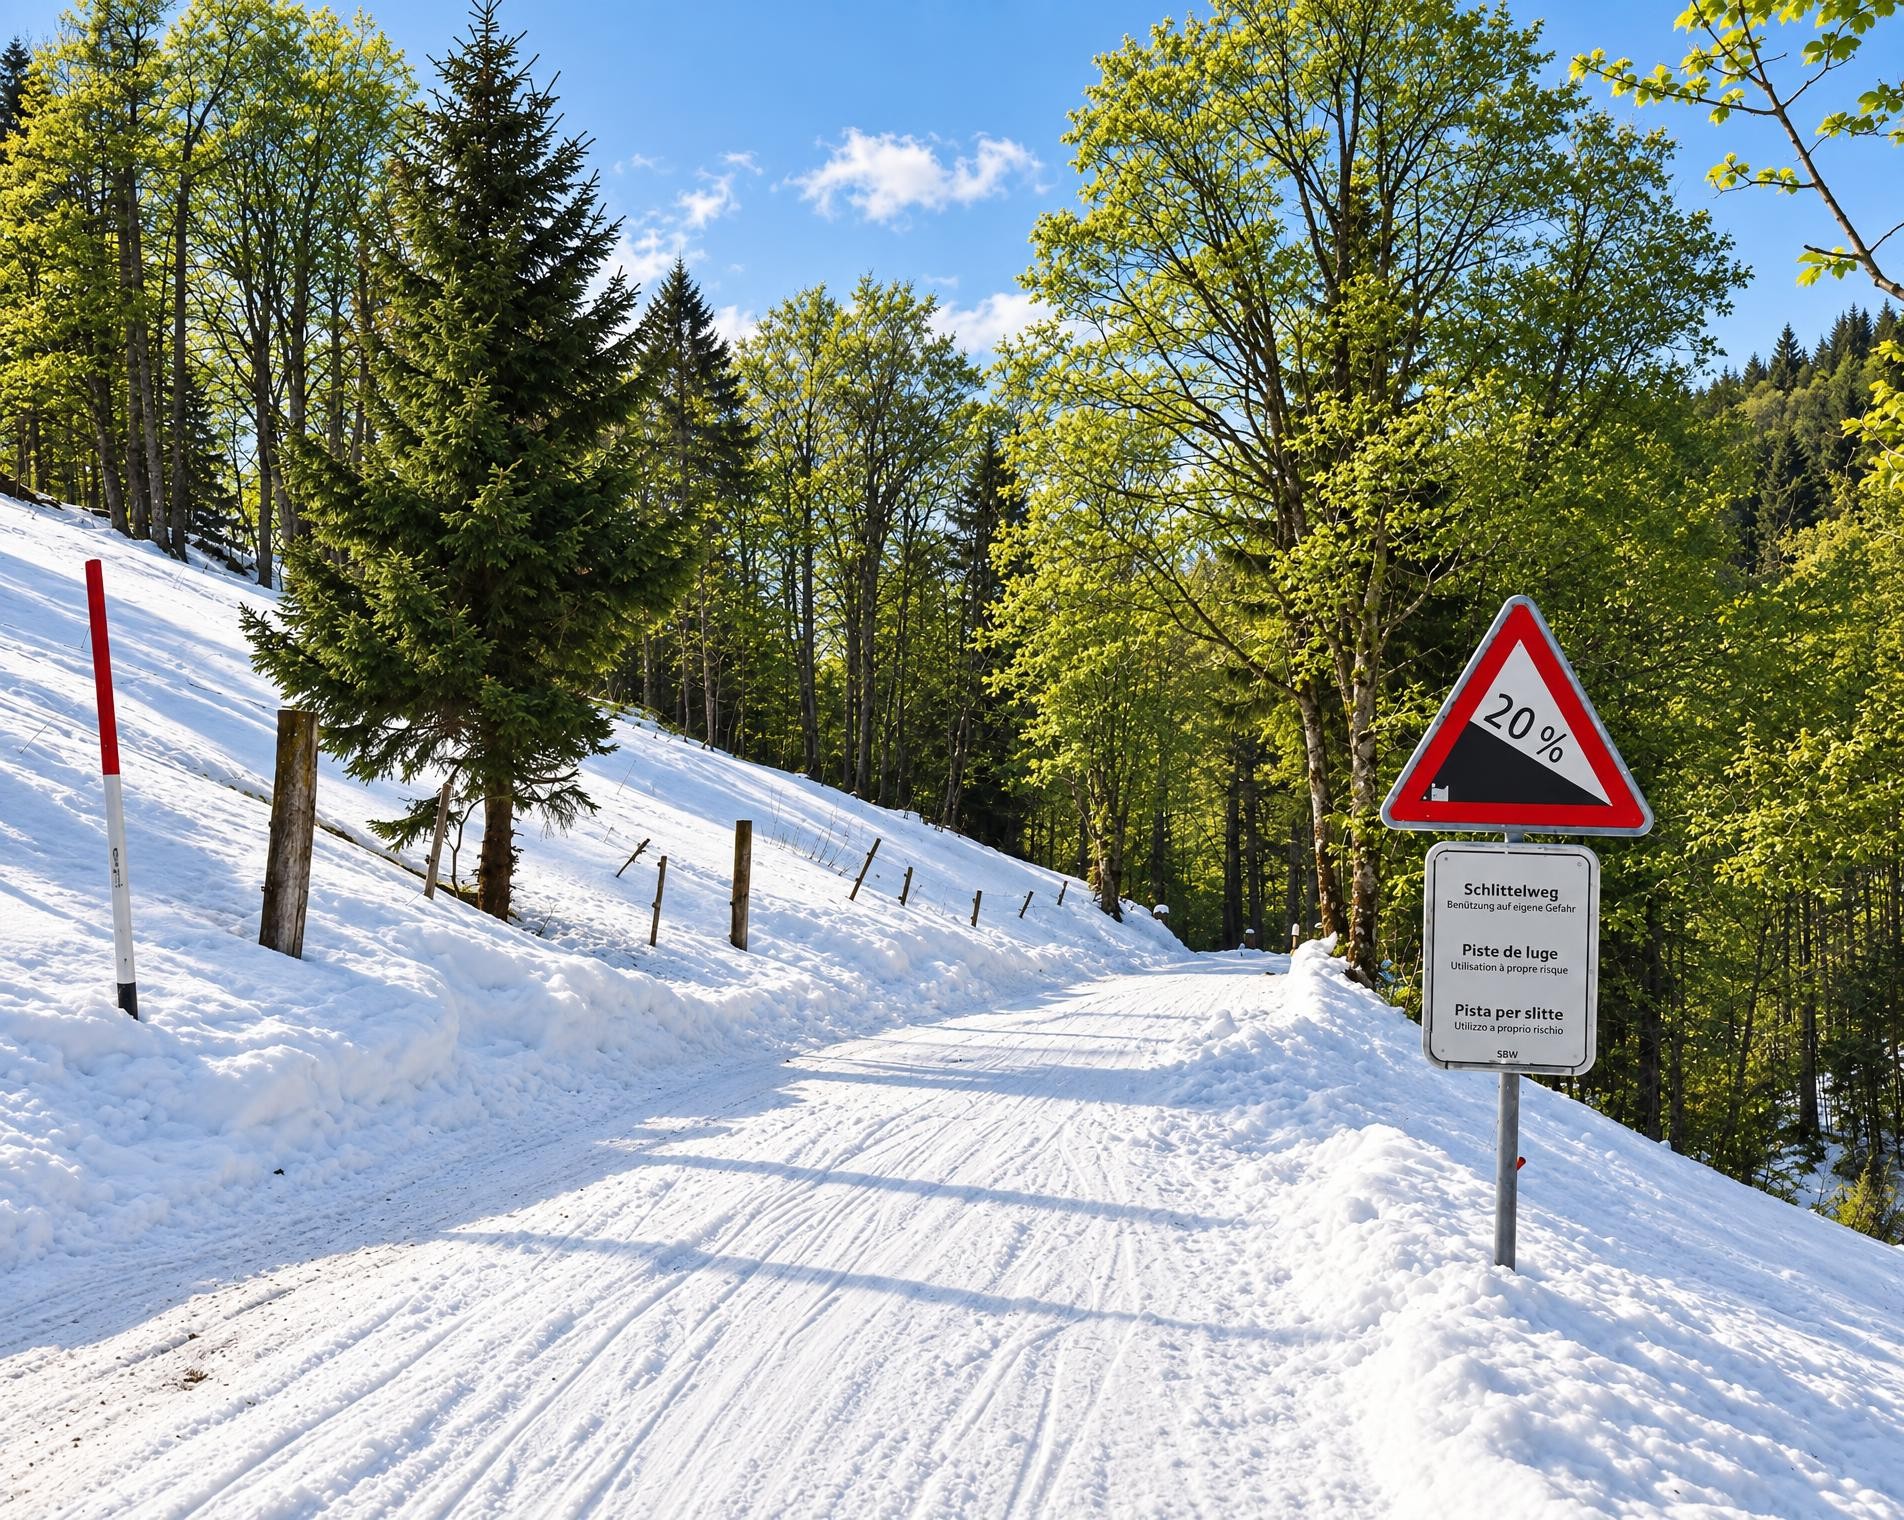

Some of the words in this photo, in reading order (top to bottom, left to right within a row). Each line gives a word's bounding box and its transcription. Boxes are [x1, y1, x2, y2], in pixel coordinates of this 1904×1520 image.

[1483, 693, 1536, 740] 20
[1536, 725, 1567, 763] %
[1464, 883, 1559, 902] Schlittelweg
[1447, 900, 1495, 913] Benützung
[1496, 902, 1512, 911] auf
[1513, 904, 1544, 914] eigene
[1545, 903, 1577, 913] Gefahr
[1462, 943, 1500, 958] Piste
[1503, 945, 1523, 959] de
[1526, 945, 1559, 963] luge
[1450, 961, 1497, 972] Utilisation
[1499, 962, 1505, 972] à
[1506, 965, 1538, 976] propre
[1540, 966, 1569, 977] risque
[1454, 1003, 1492, 1018] Pista
[1495, 1008, 1522, 1022] per
[1524, 1006, 1564, 1021] slitte
[1454, 1021, 1488, 1032] Utilizzo
[1489, 1024, 1496, 1032] a
[1497, 1025, 1532, 1036] proprio
[1533, 1025, 1564, 1036] rischio
[1496, 1050, 1519, 1059] SBW
